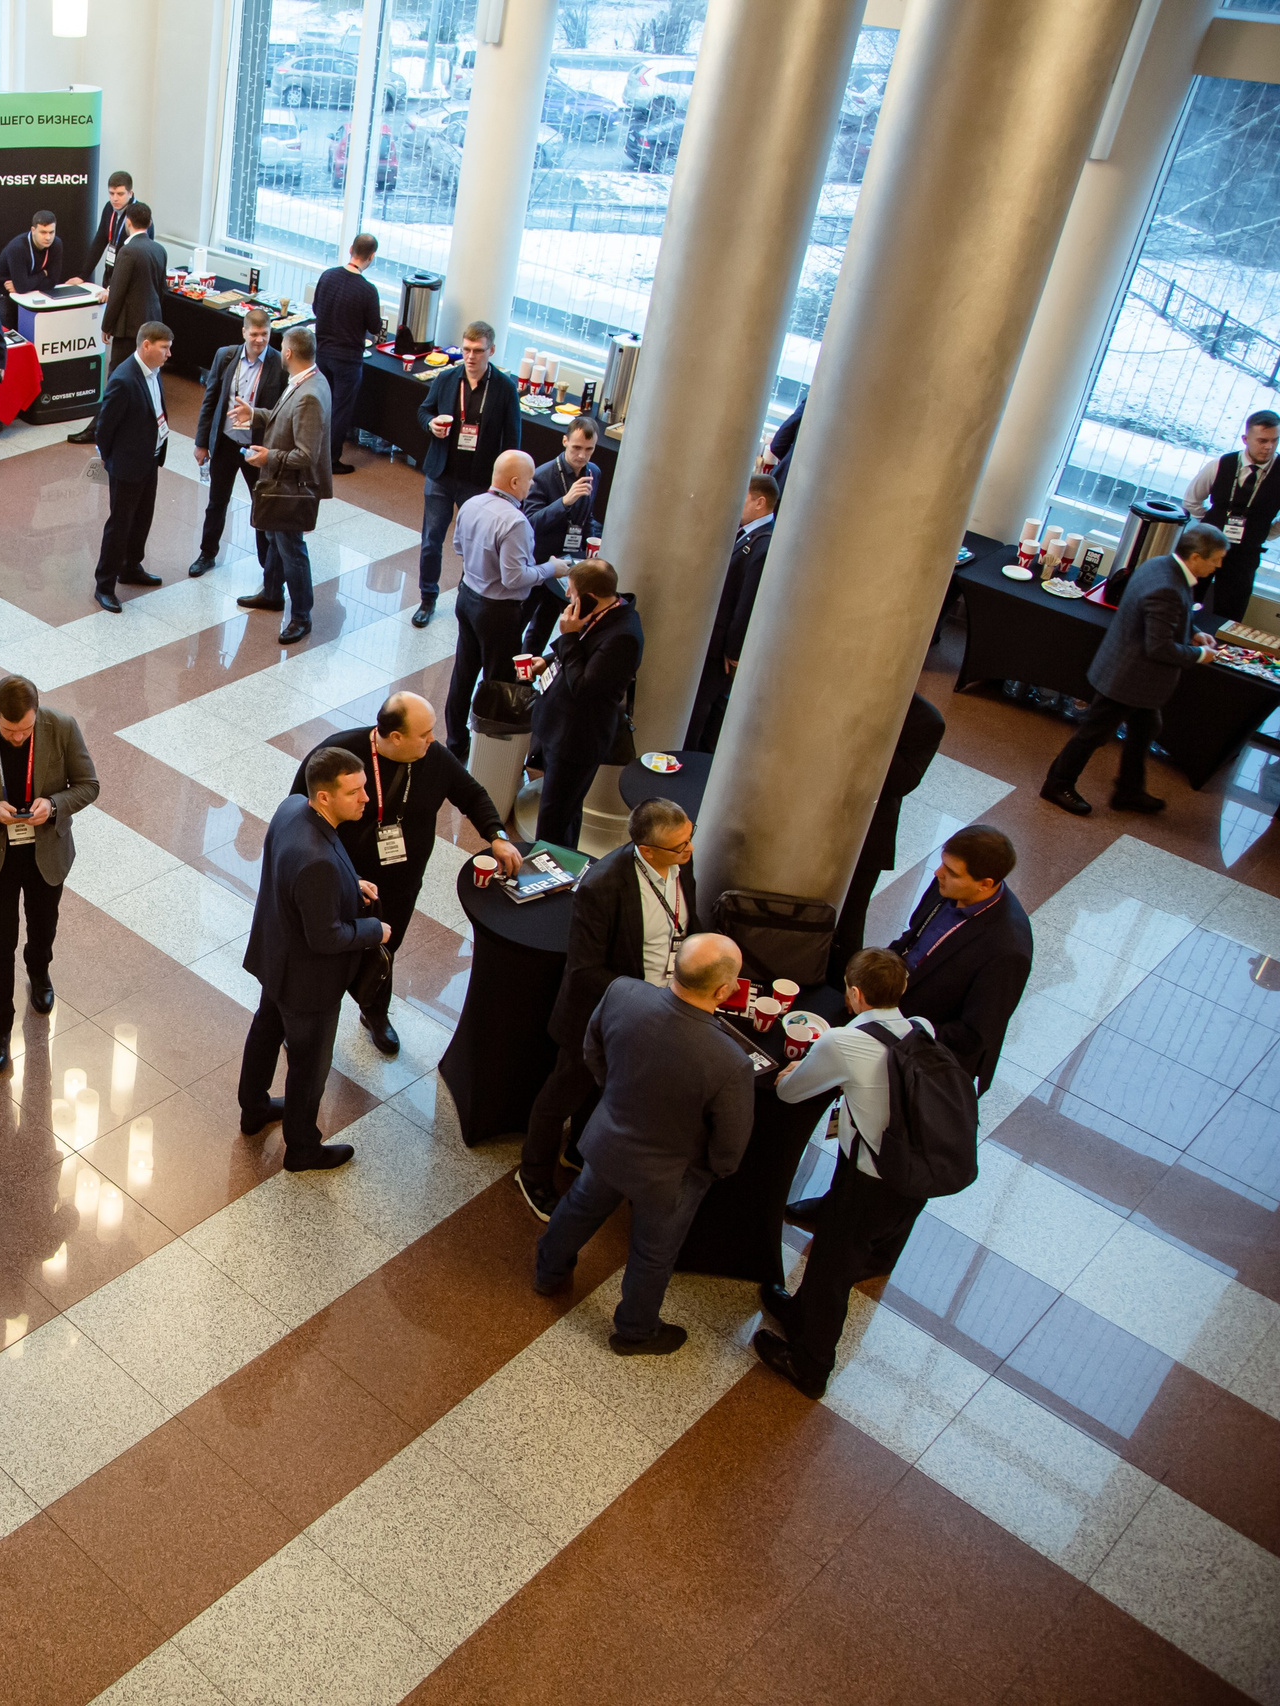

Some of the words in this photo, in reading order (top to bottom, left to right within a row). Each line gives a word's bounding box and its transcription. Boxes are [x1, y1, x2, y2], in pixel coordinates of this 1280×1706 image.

[37, 115, 94, 125] БИЗНЕСА
[39, 174, 88, 185] SEARCH
[42, 337, 96, 355] FEMIDA
[52, 392, 75, 400] ODYSSEY
[76, 389, 95, 397] SEARCH
[520, 878, 560, 894] 2023
